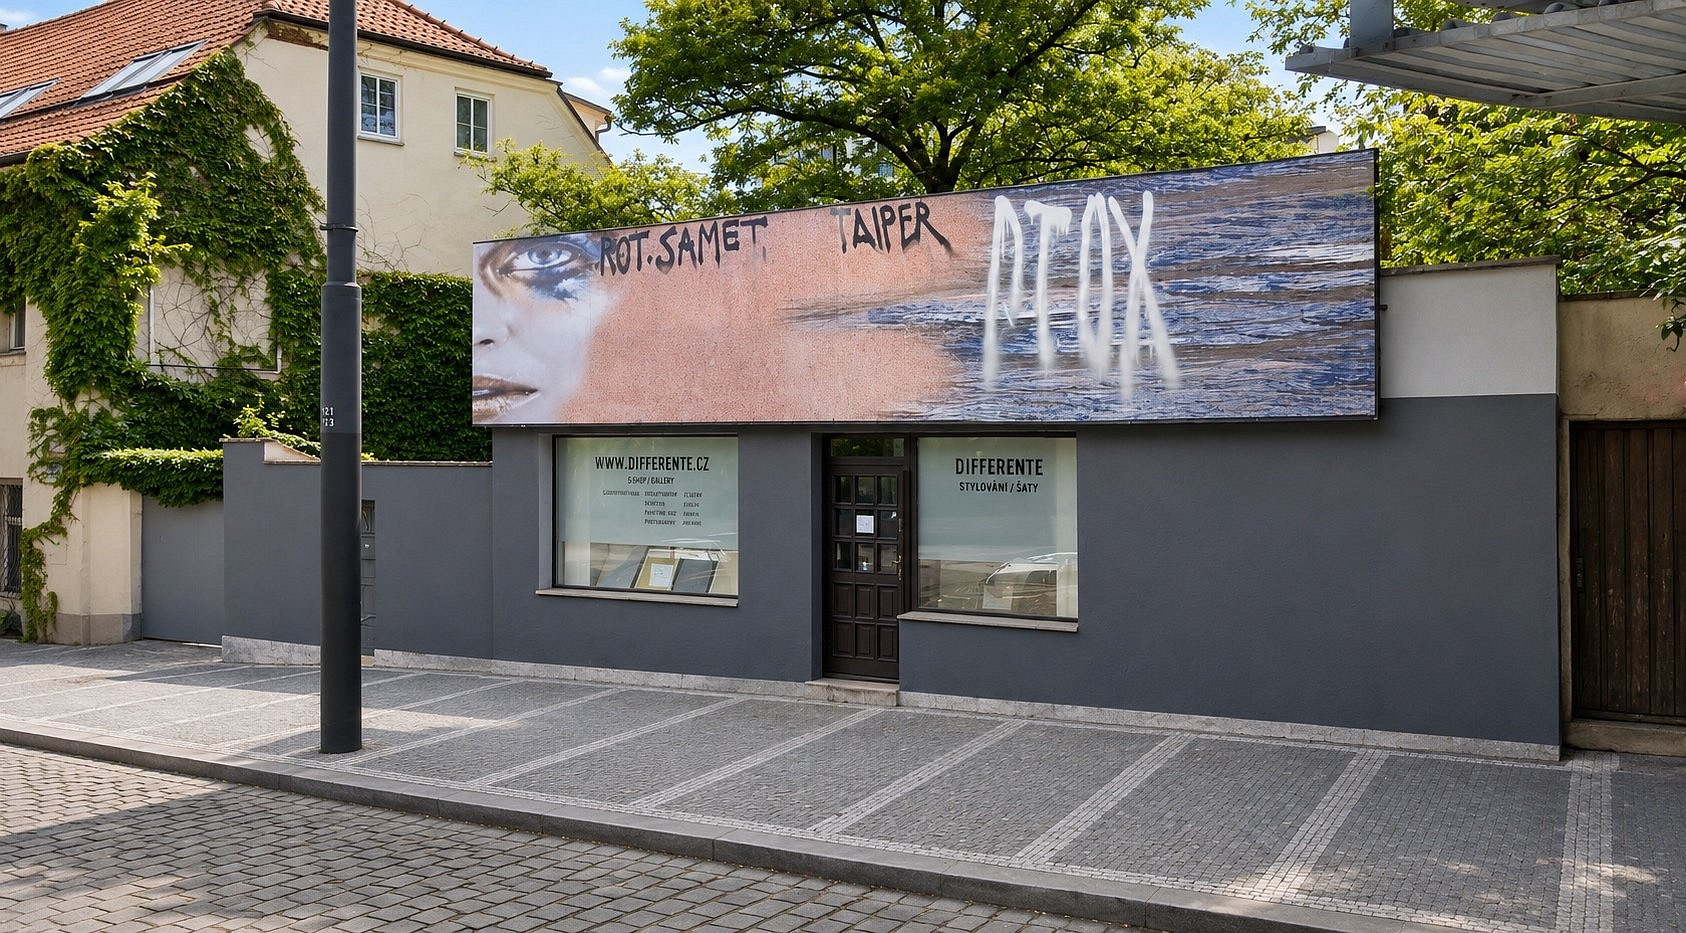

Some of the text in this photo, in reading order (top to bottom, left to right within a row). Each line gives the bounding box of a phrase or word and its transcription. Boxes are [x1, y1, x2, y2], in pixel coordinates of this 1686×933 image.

[595, 456, 709, 471] WWW.DIFFERENTE.CZ
[955, 458, 1043, 475] DIFFERENTE
[1009, 483, 1015, 493] /
[1016, 480, 1039, 493] ŠATY
